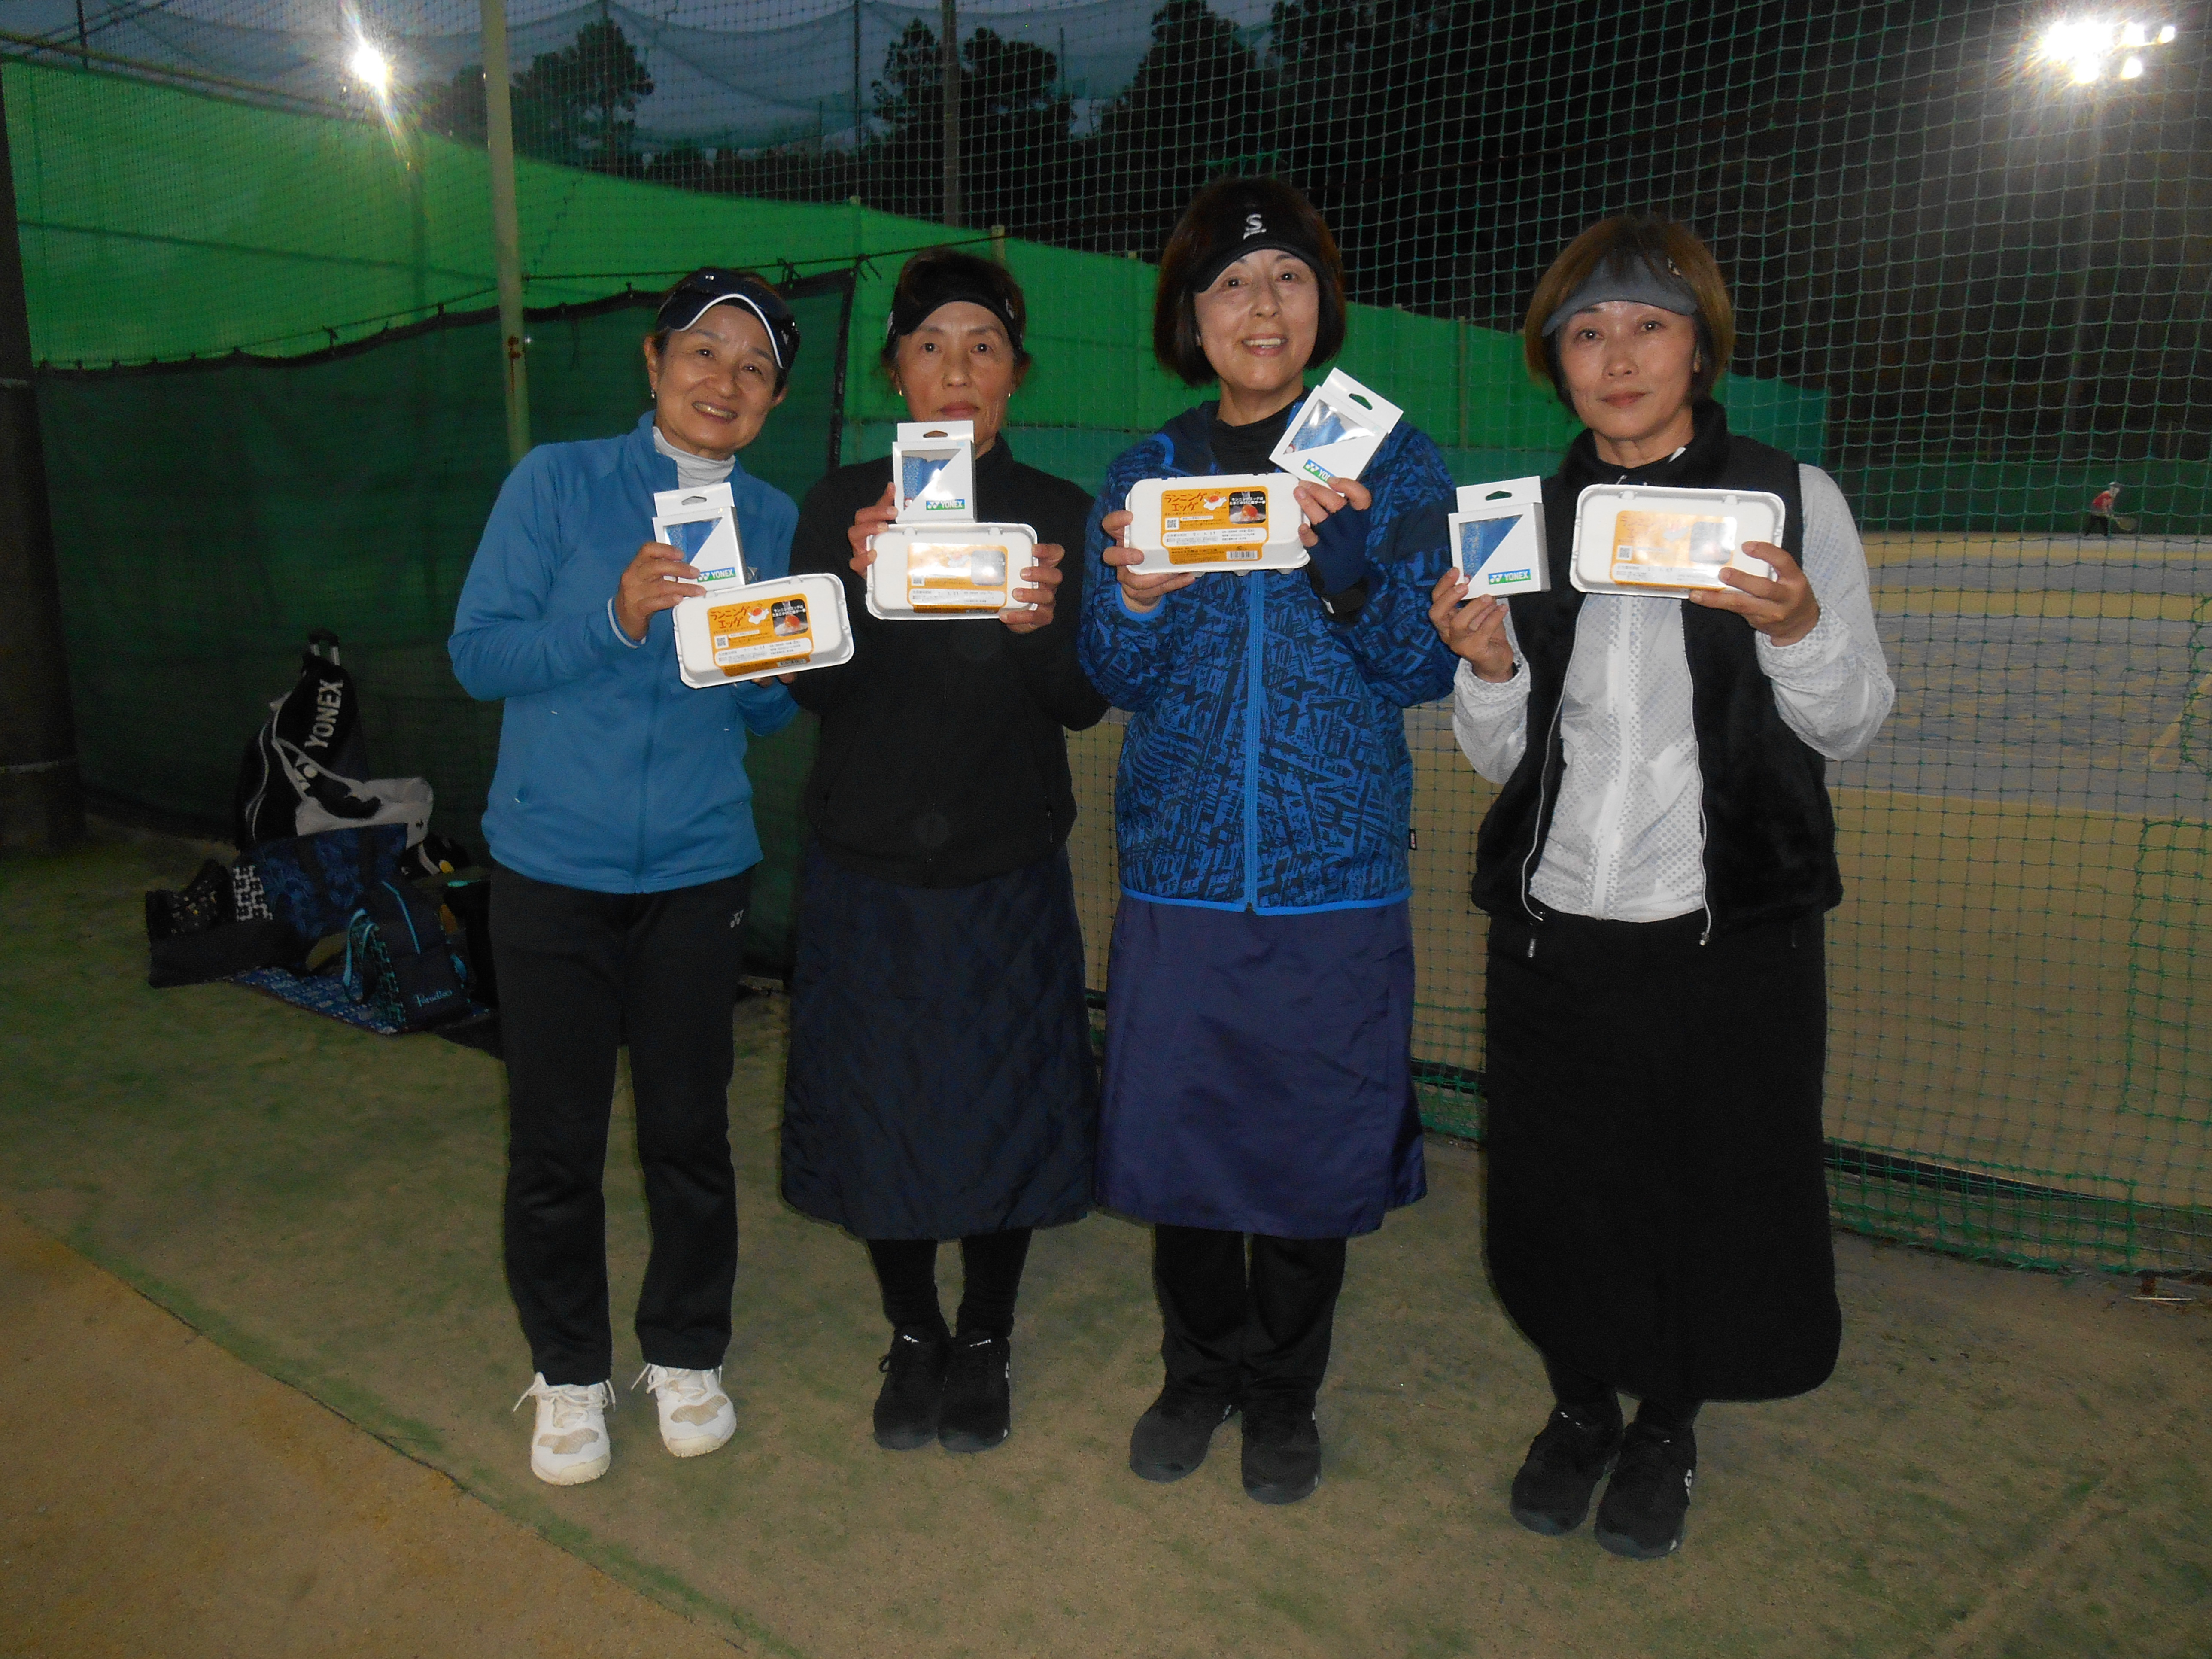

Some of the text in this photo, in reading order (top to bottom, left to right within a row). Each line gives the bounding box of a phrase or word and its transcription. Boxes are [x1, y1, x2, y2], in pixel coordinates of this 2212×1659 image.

[1164, 492, 1207, 503] ランニング
[941, 501, 963, 509] YONEX
[1172, 502, 1198, 511] エッグ
[711, 569, 733, 579] YONEX
[1504, 571, 1528, 581] YONEX
[710, 606, 750, 620] ランニング
[719, 617, 743, 628] エッグ
[304, 678, 343, 748] YONEX
